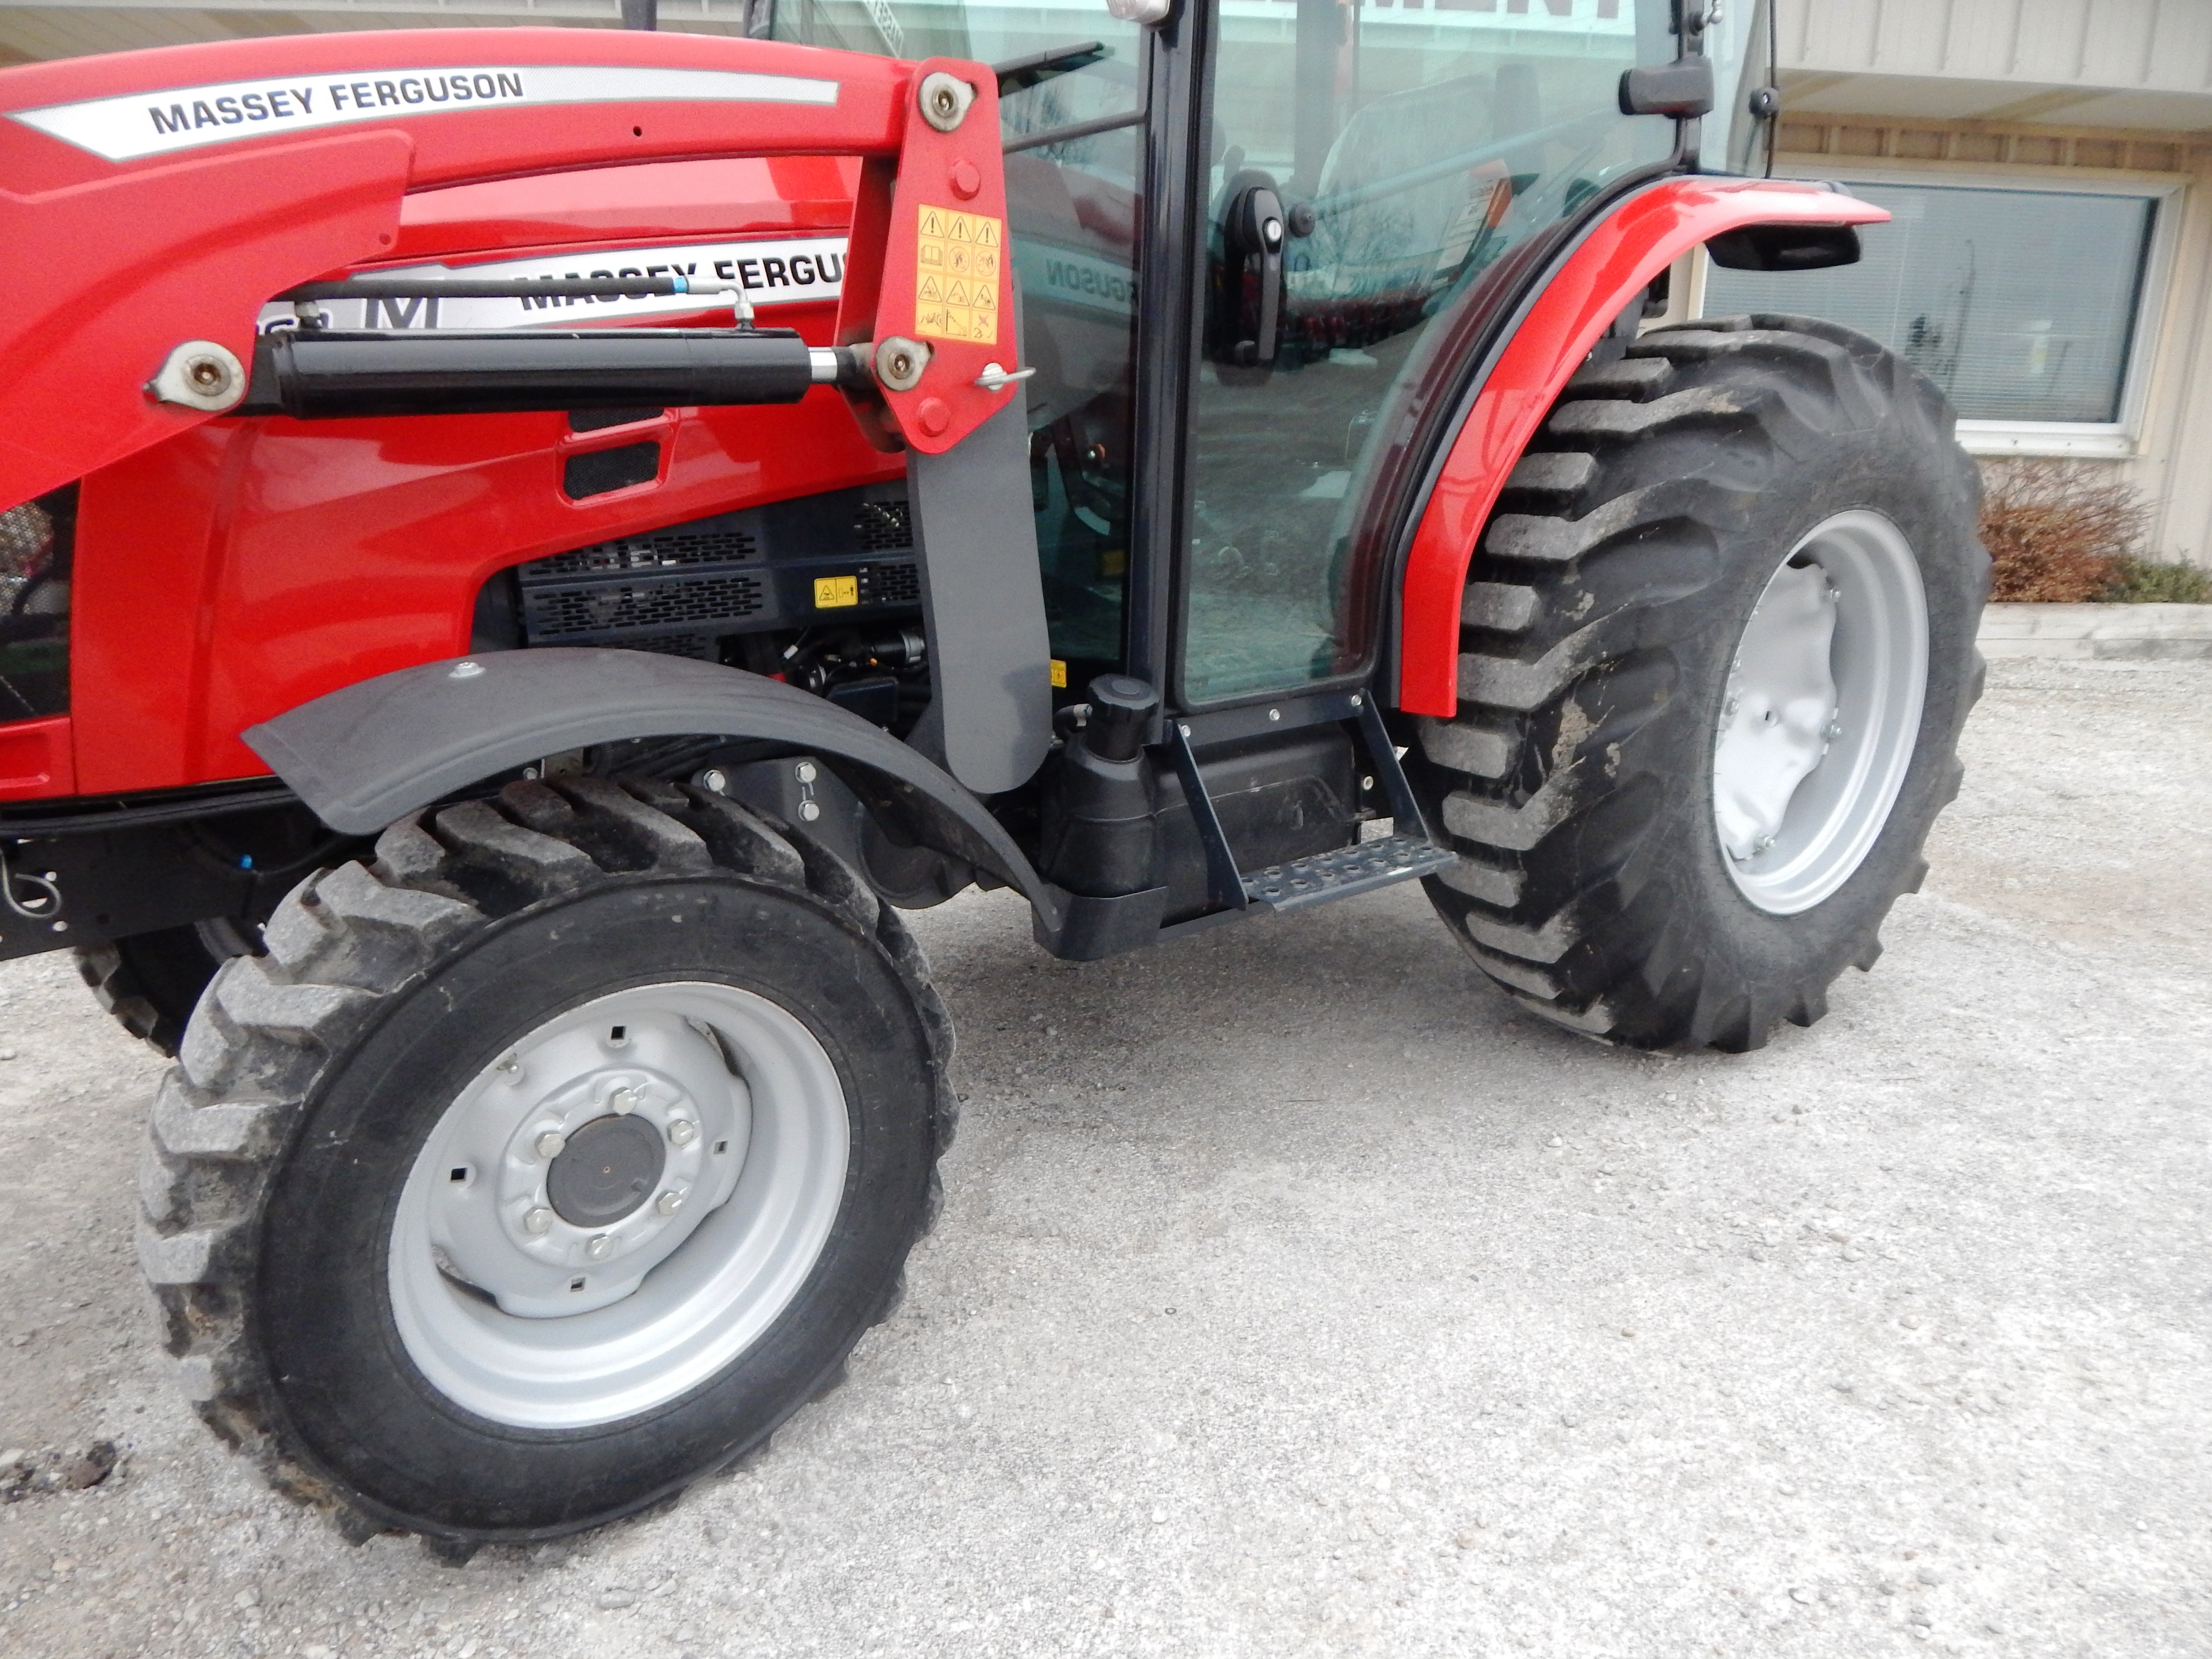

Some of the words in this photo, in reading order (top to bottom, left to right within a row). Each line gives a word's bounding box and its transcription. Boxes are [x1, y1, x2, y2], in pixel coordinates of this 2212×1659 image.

[148, 87, 313, 135] MASSEY
[329, 72, 524, 110] FERGUSON
[714, 252, 848, 289] FERGU
